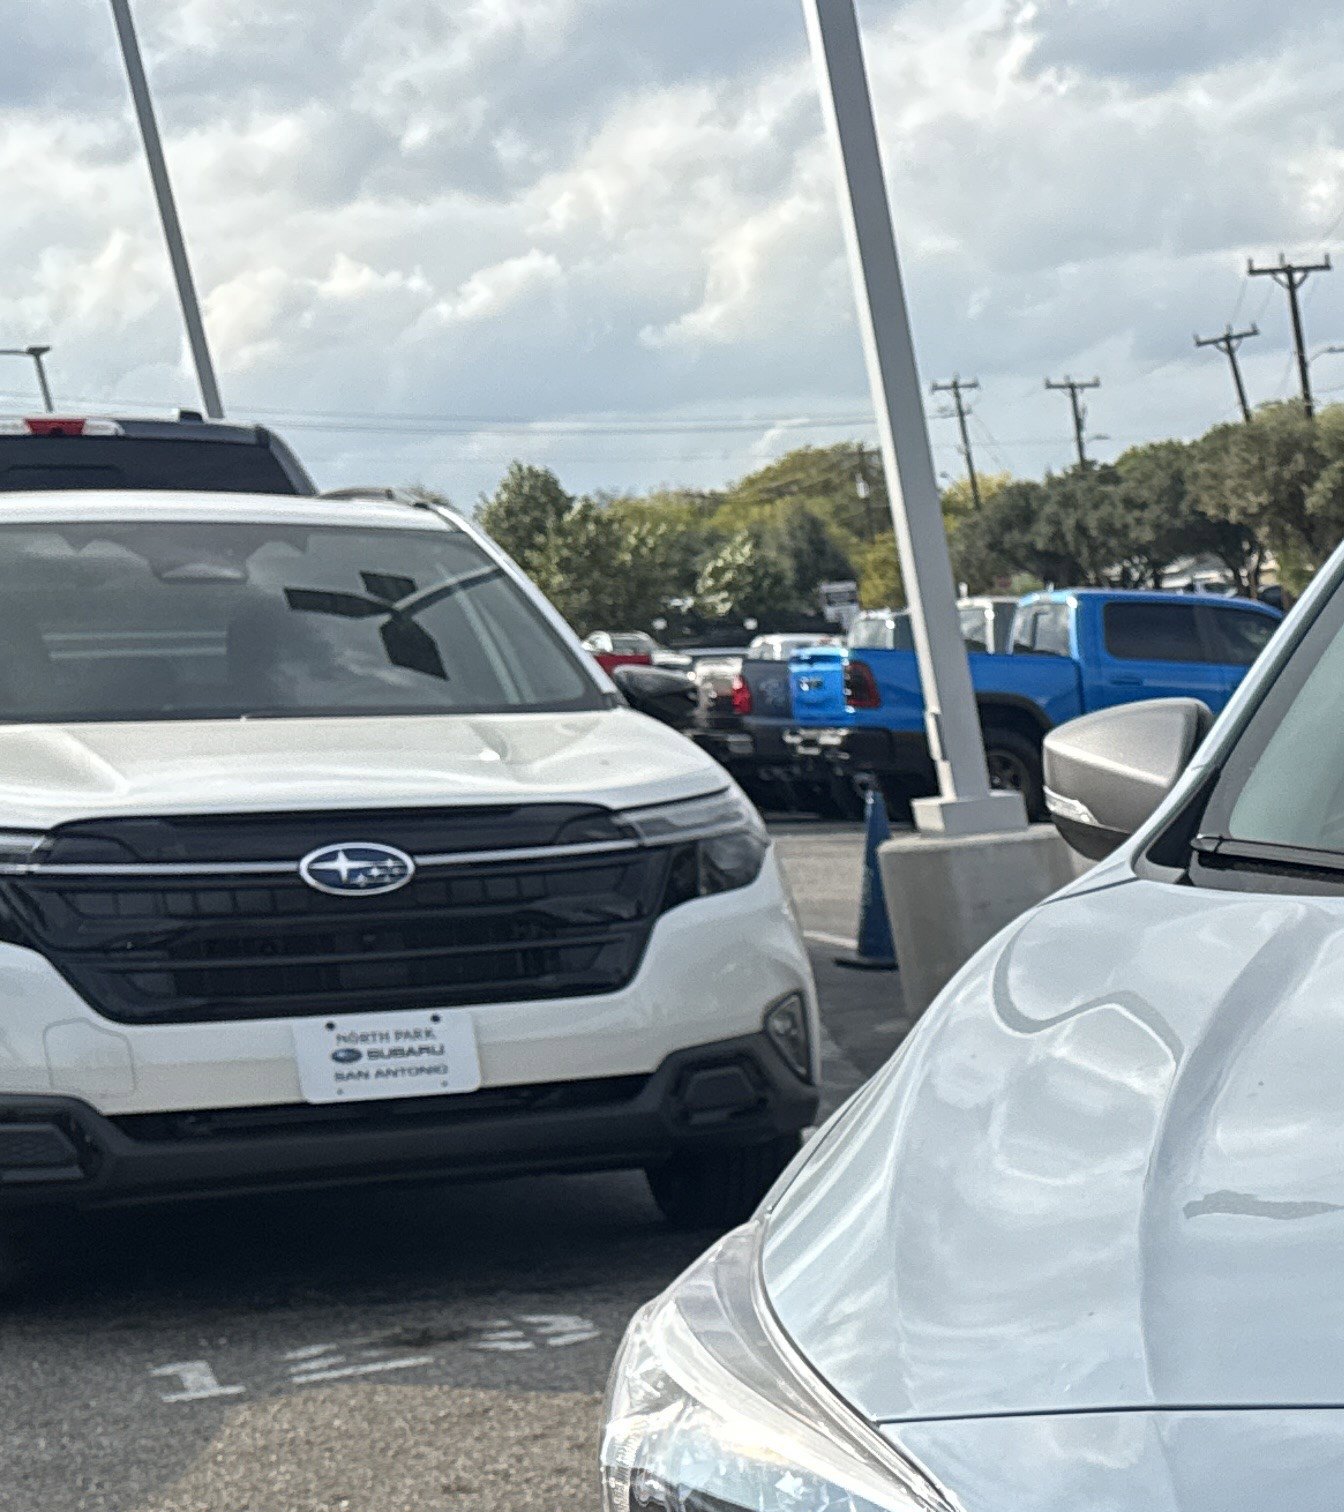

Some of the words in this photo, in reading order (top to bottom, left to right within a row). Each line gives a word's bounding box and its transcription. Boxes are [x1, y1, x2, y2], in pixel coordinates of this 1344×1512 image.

[336, 1031, 390, 1045] NORTH
[394, 1027, 436, 1042] PARK
[366, 1044, 445, 1060] SUBARU
[334, 1071, 370, 1082] SAN
[374, 1064, 448, 1079] ANTONIO
